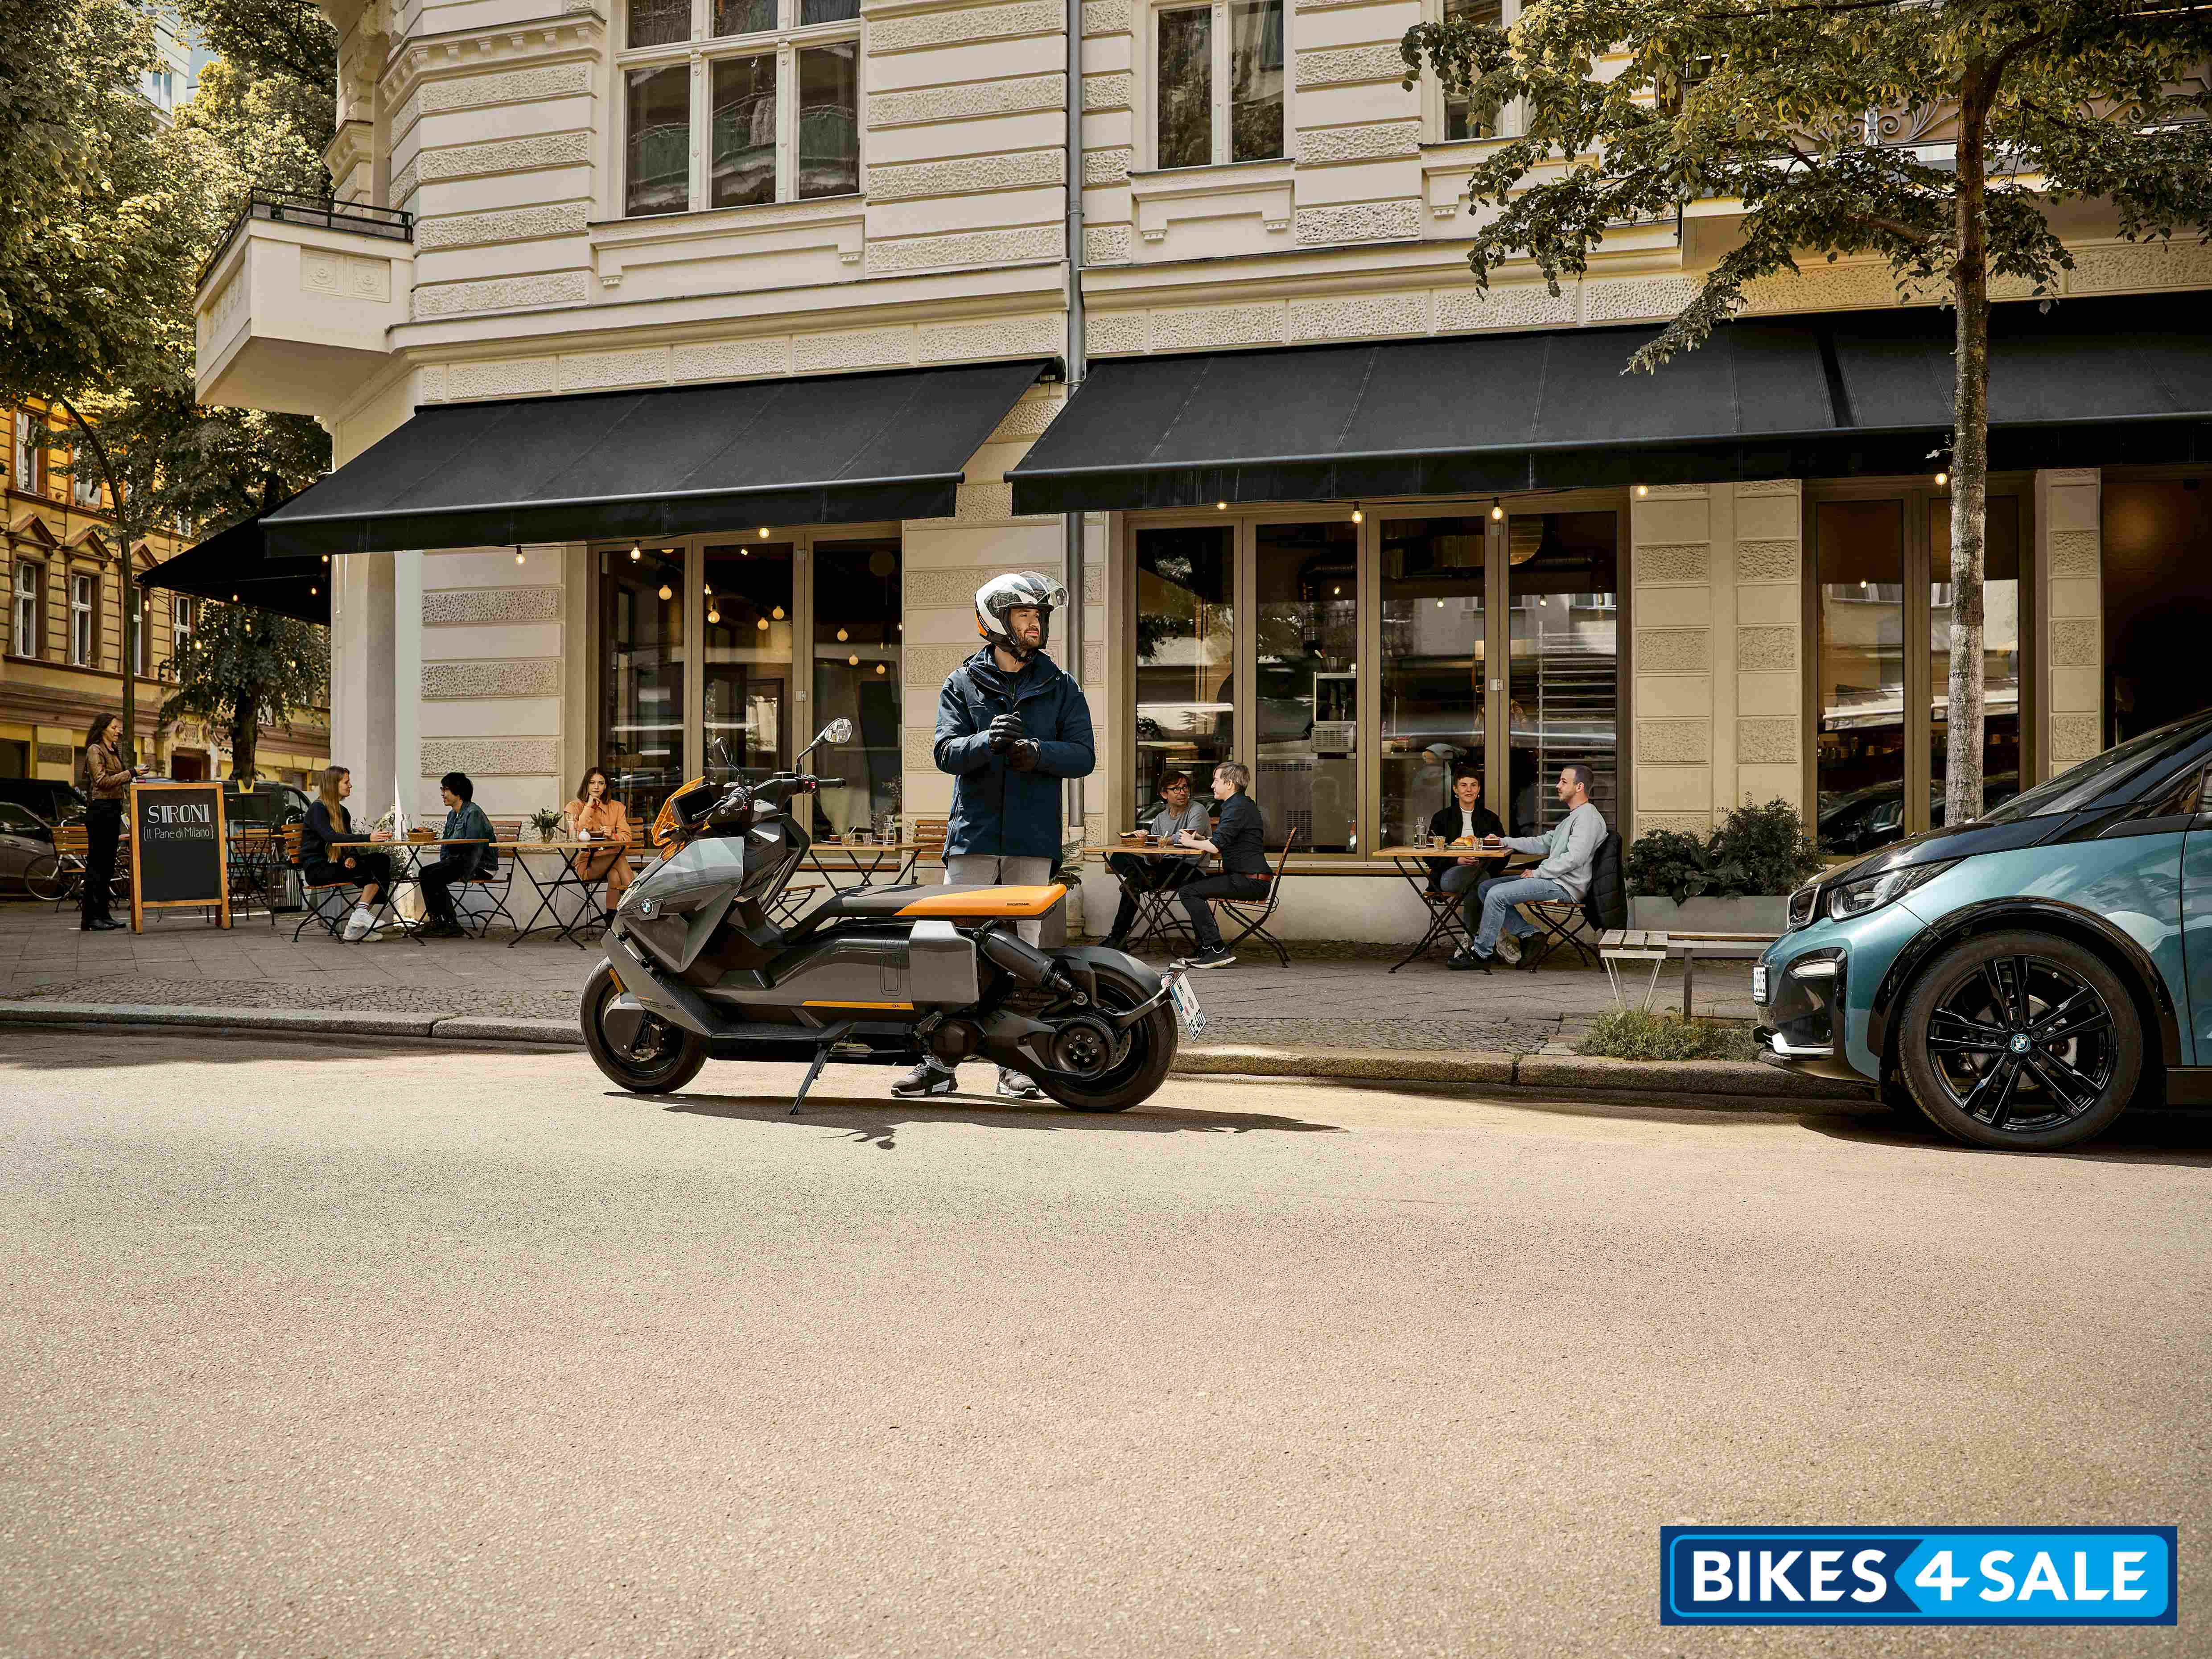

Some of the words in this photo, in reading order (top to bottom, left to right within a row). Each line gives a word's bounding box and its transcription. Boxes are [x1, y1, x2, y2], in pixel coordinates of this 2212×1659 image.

[148, 804, 210, 823] SIRONI
[154, 828, 175, 839] Pane
[175, 827, 183, 838] di
